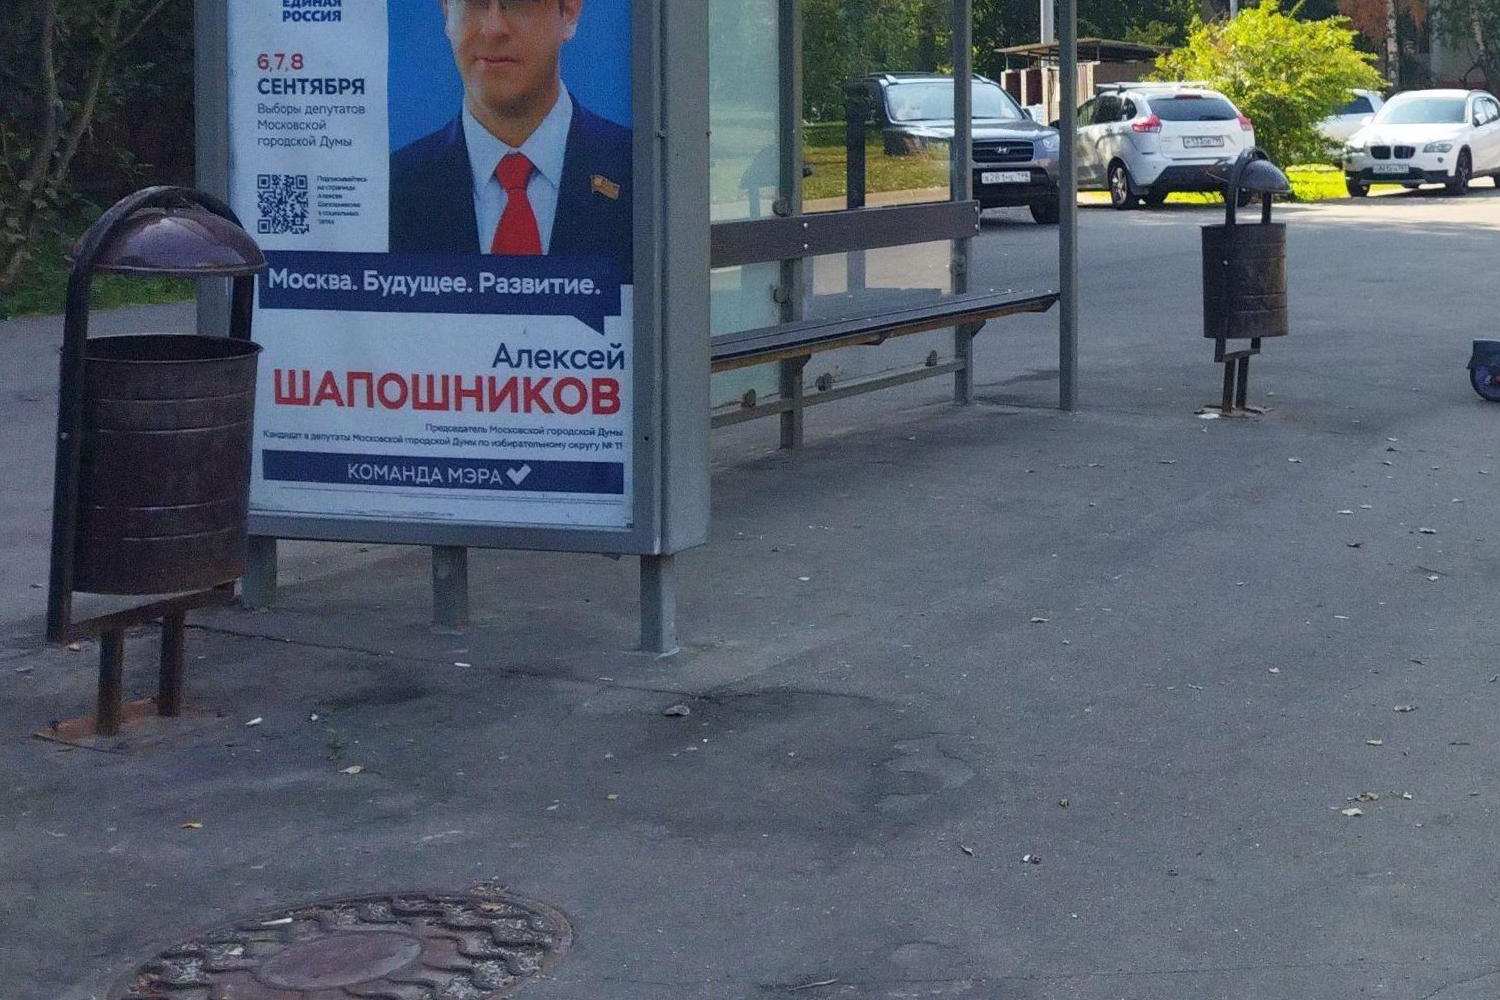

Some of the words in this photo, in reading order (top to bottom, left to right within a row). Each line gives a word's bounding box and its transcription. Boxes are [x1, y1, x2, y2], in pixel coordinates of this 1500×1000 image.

[282, 9, 342, 22] РОССИЯ
[256, 53, 304, 73] 6,7,8
[256, 78, 366, 95] СЕНТЯБРЯ
[257, 102, 301, 116] Выборы
[304, 104, 366, 117] депутатов
[257, 119, 327, 130] Московской
[257, 135, 317, 148] городской
[319, 135, 353, 149] Думы
[268, 268, 358, 291] Москва.
[363, 270, 473, 297] Будущее.
[478, 272, 601, 295] Развитие.
[491, 342, 625, 370] Алексей
[273, 368, 622, 416] ШАПОШНИКОВ
[425, 423, 488, 435] Председатель
[489, 425, 545, 435] Московской
[546, 427, 595, 437] городской
[597, 428, 624, 438] Думы
[263, 430, 302, 440] Кандидат
[310, 433, 351, 442] депутаты
[352, 434, 404, 444] Московской
[405, 436, 451, 446] городской
[452, 437, 476, 447] Думы
[478, 439, 489, 448] по
[490, 438, 566, 449] избирательному
[568, 441, 600, 451] округу
[347, 463, 444, 485] КОМАНДА
[447, 467, 504, 486] МЭРА
